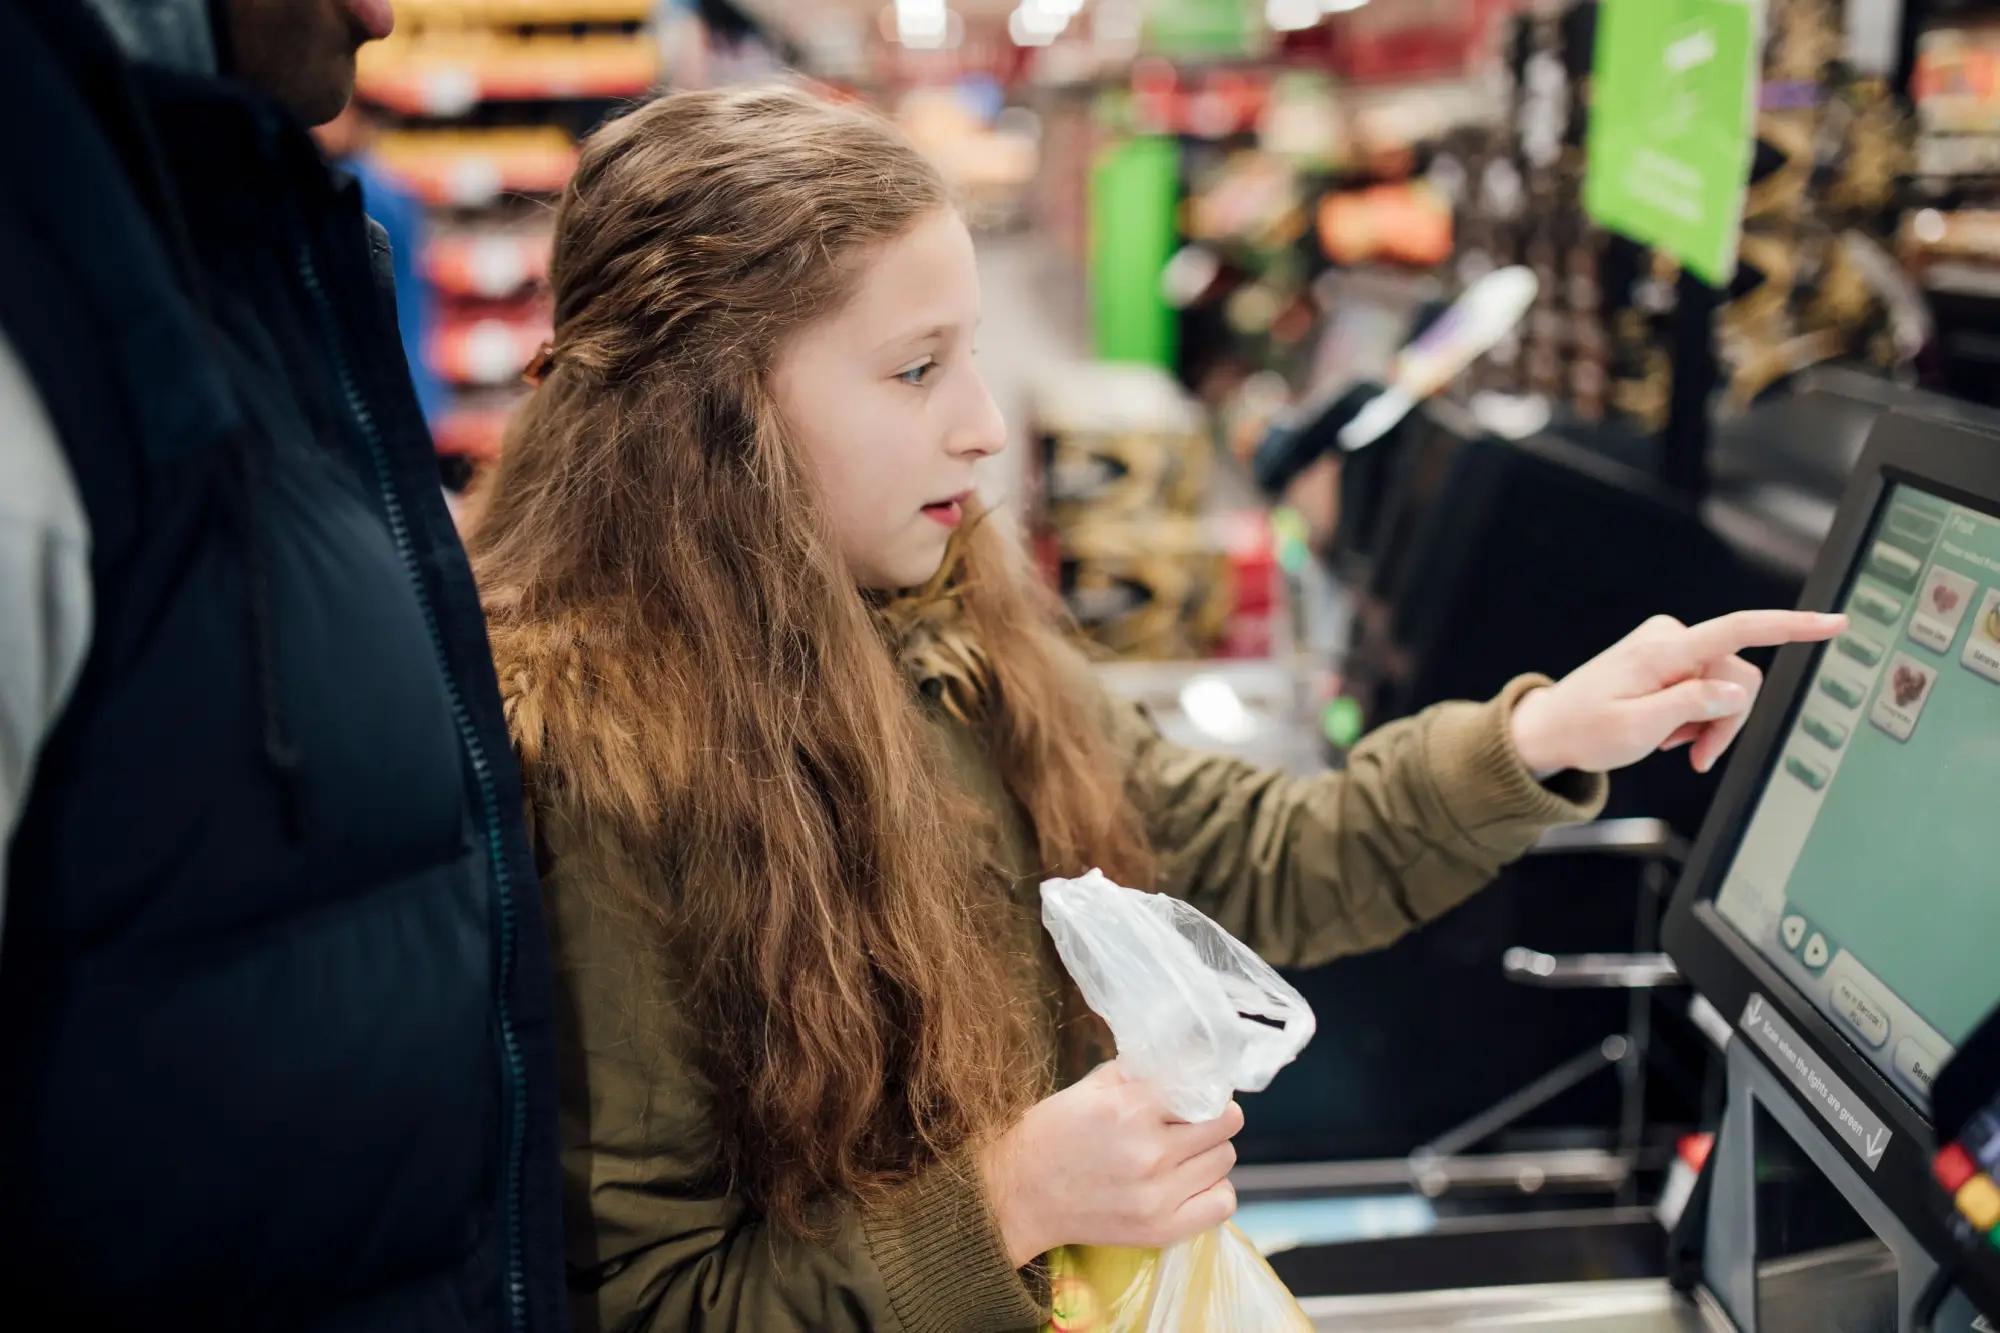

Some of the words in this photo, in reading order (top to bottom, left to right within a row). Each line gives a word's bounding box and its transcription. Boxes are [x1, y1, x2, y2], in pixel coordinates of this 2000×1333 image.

[1778, 1040, 1797, 1063] when
[1796, 1057, 1809, 1077] the
[1807, 1069, 1829, 1098] lights
[1827, 1094, 1841, 1112] are
[1839, 1107, 1864, 1136] green
